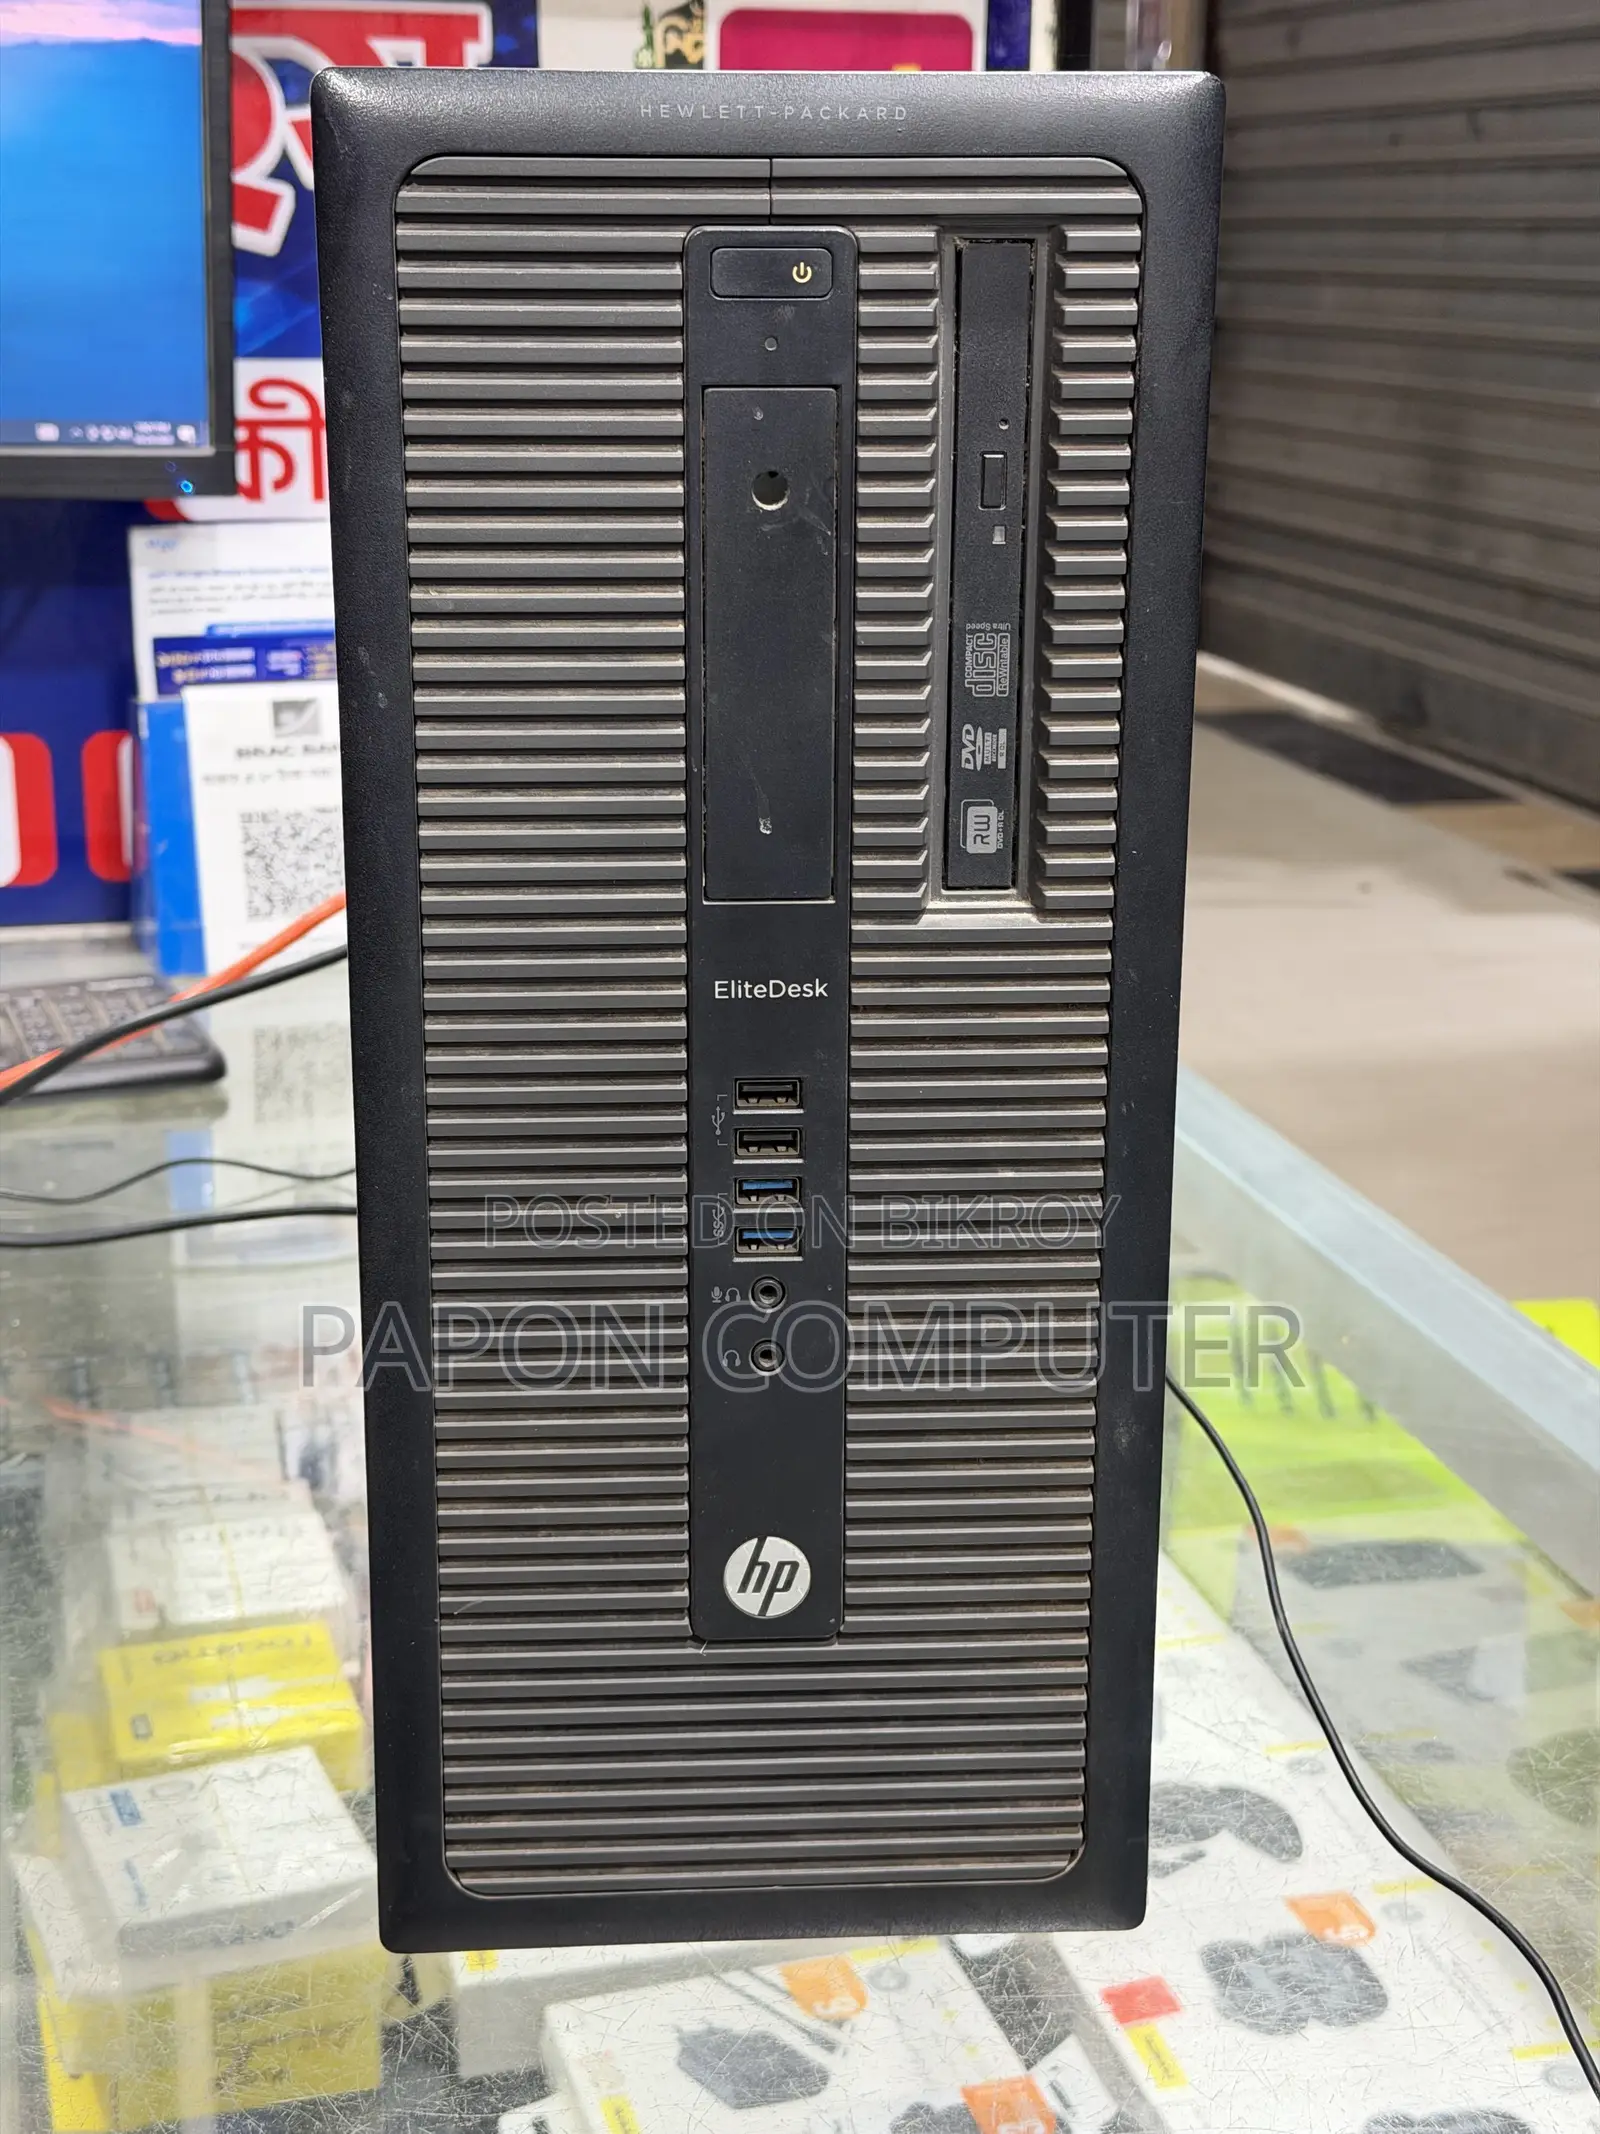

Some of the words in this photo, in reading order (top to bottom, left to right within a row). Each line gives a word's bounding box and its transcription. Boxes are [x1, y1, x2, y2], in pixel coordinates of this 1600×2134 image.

[640, 104, 908, 120] HEWLETT-PACKARD
[966, 622, 991, 631] Speed
[964, 633, 974, 678] COMPACT
[961, 723, 975, 770] DVD
[973, 814, 991, 845] RW
[714, 978, 829, 999] EliteDesk
[732, 1536, 805, 1617] hp
